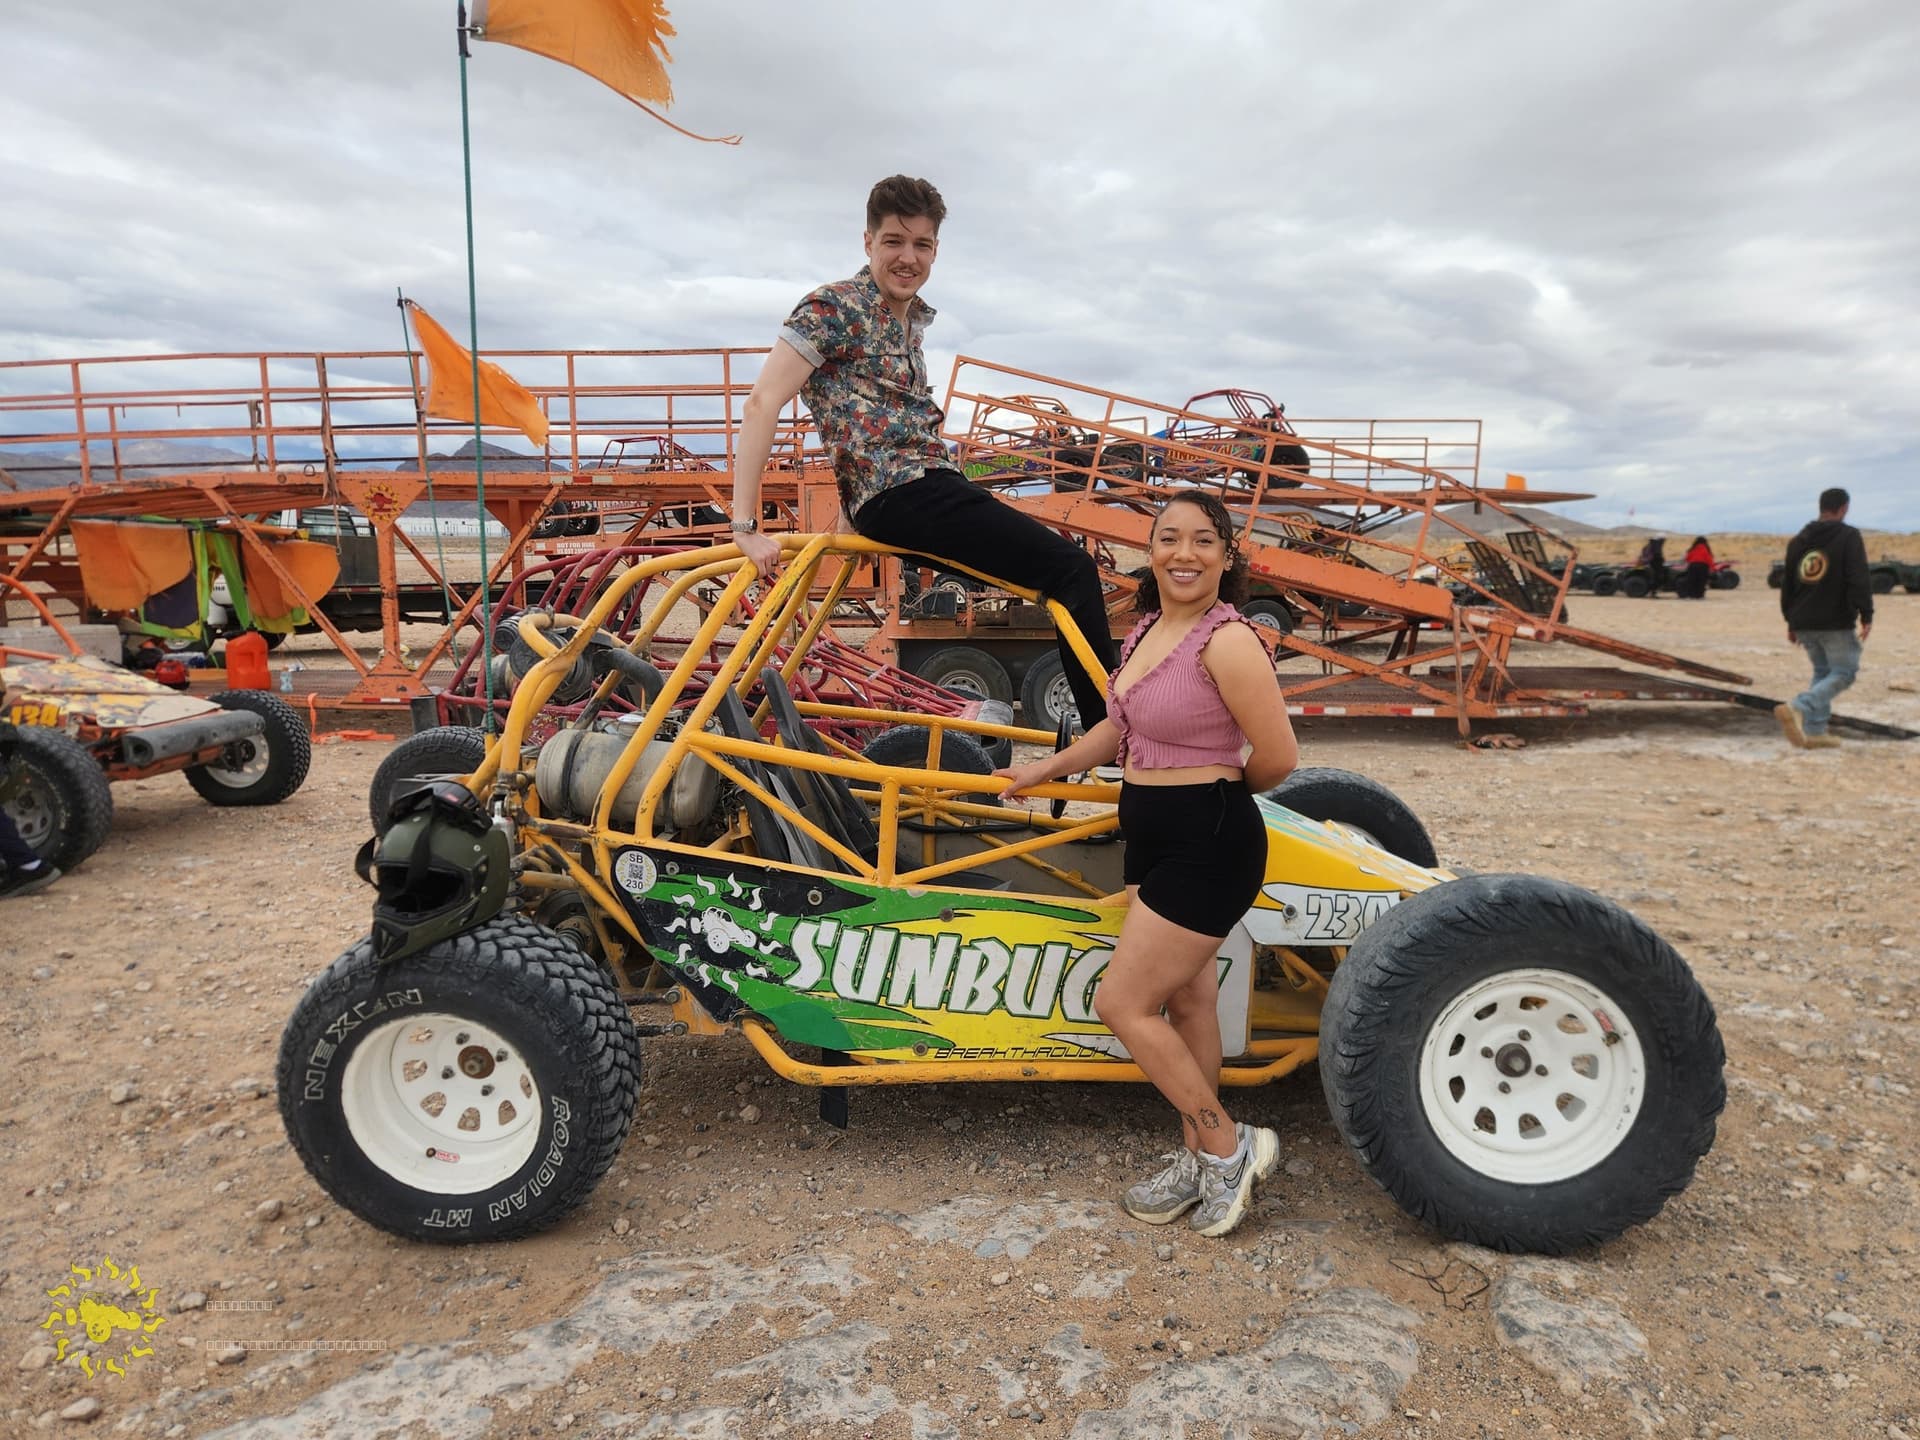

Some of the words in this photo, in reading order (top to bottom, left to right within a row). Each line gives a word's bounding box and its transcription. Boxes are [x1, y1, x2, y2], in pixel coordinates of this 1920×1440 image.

[629, 853, 644, 864] SB
[626, 879, 644, 890] 230
[781, 917, 1233, 1023] SUNBUG
[934, 1045, 1111, 1059] BREAKTHROUGH
[489, 1096, 571, 1222] ROADIAN
[423, 1208, 473, 1228] MT
